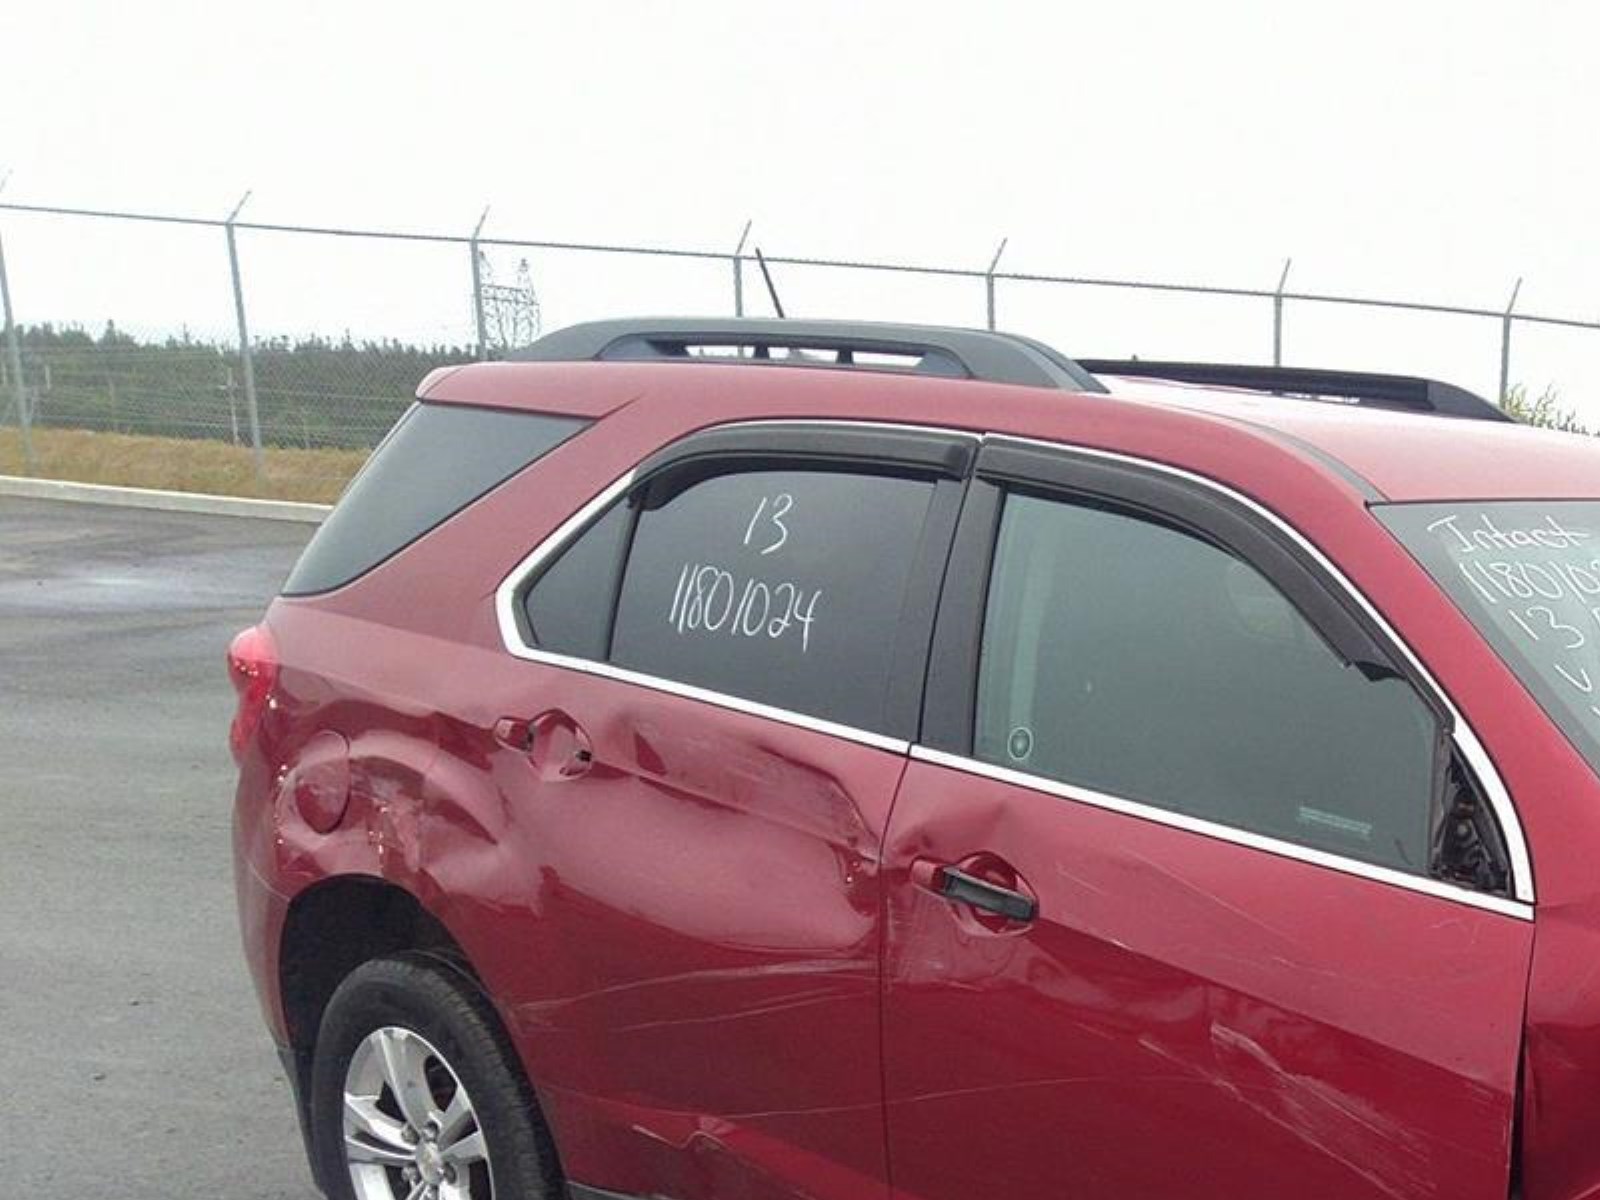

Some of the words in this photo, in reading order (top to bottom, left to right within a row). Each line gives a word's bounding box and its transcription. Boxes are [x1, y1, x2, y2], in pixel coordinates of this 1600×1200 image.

[743, 493, 793, 555] 13
[1427, 514, 1590, 552] Intact
[668, 562, 823, 653] 11801024
[1507, 605, 1585, 649] 13
